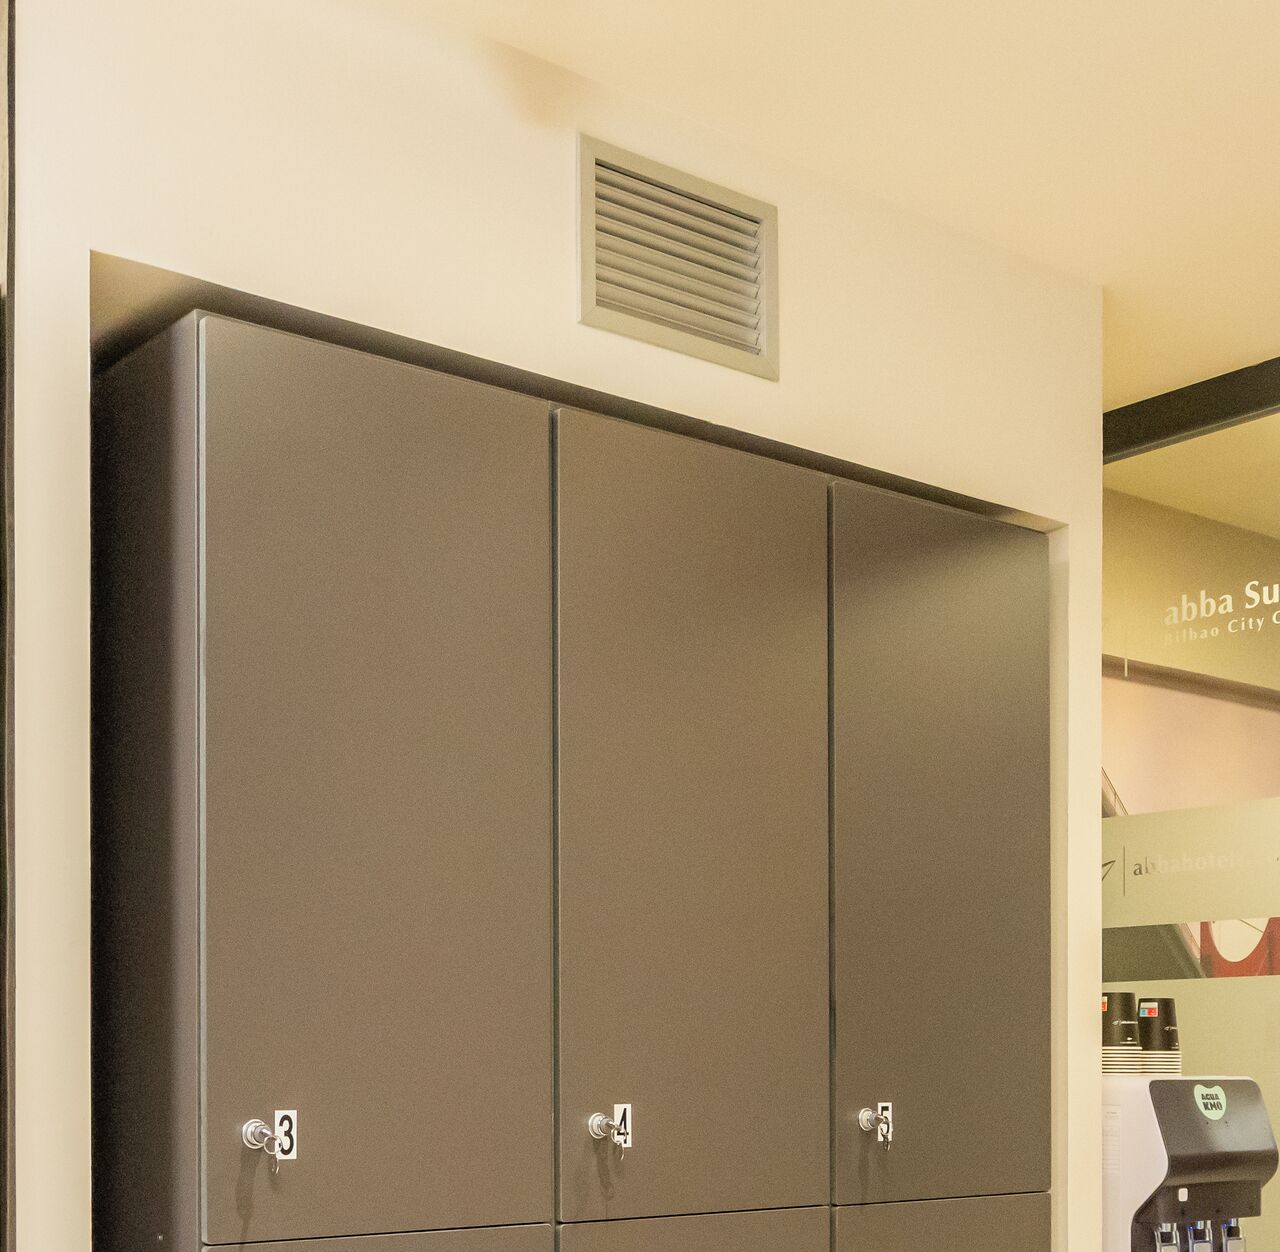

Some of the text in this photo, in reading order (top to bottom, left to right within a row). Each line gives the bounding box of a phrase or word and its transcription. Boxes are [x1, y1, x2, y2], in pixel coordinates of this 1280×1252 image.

[1164, 590, 1234, 625] abba
[1227, 617, 1265, 633] City
[279, 1114, 294, 1156] 3
[616, 1107, 629, 1144] 4
[880, 1106, 890, 1135] 5
